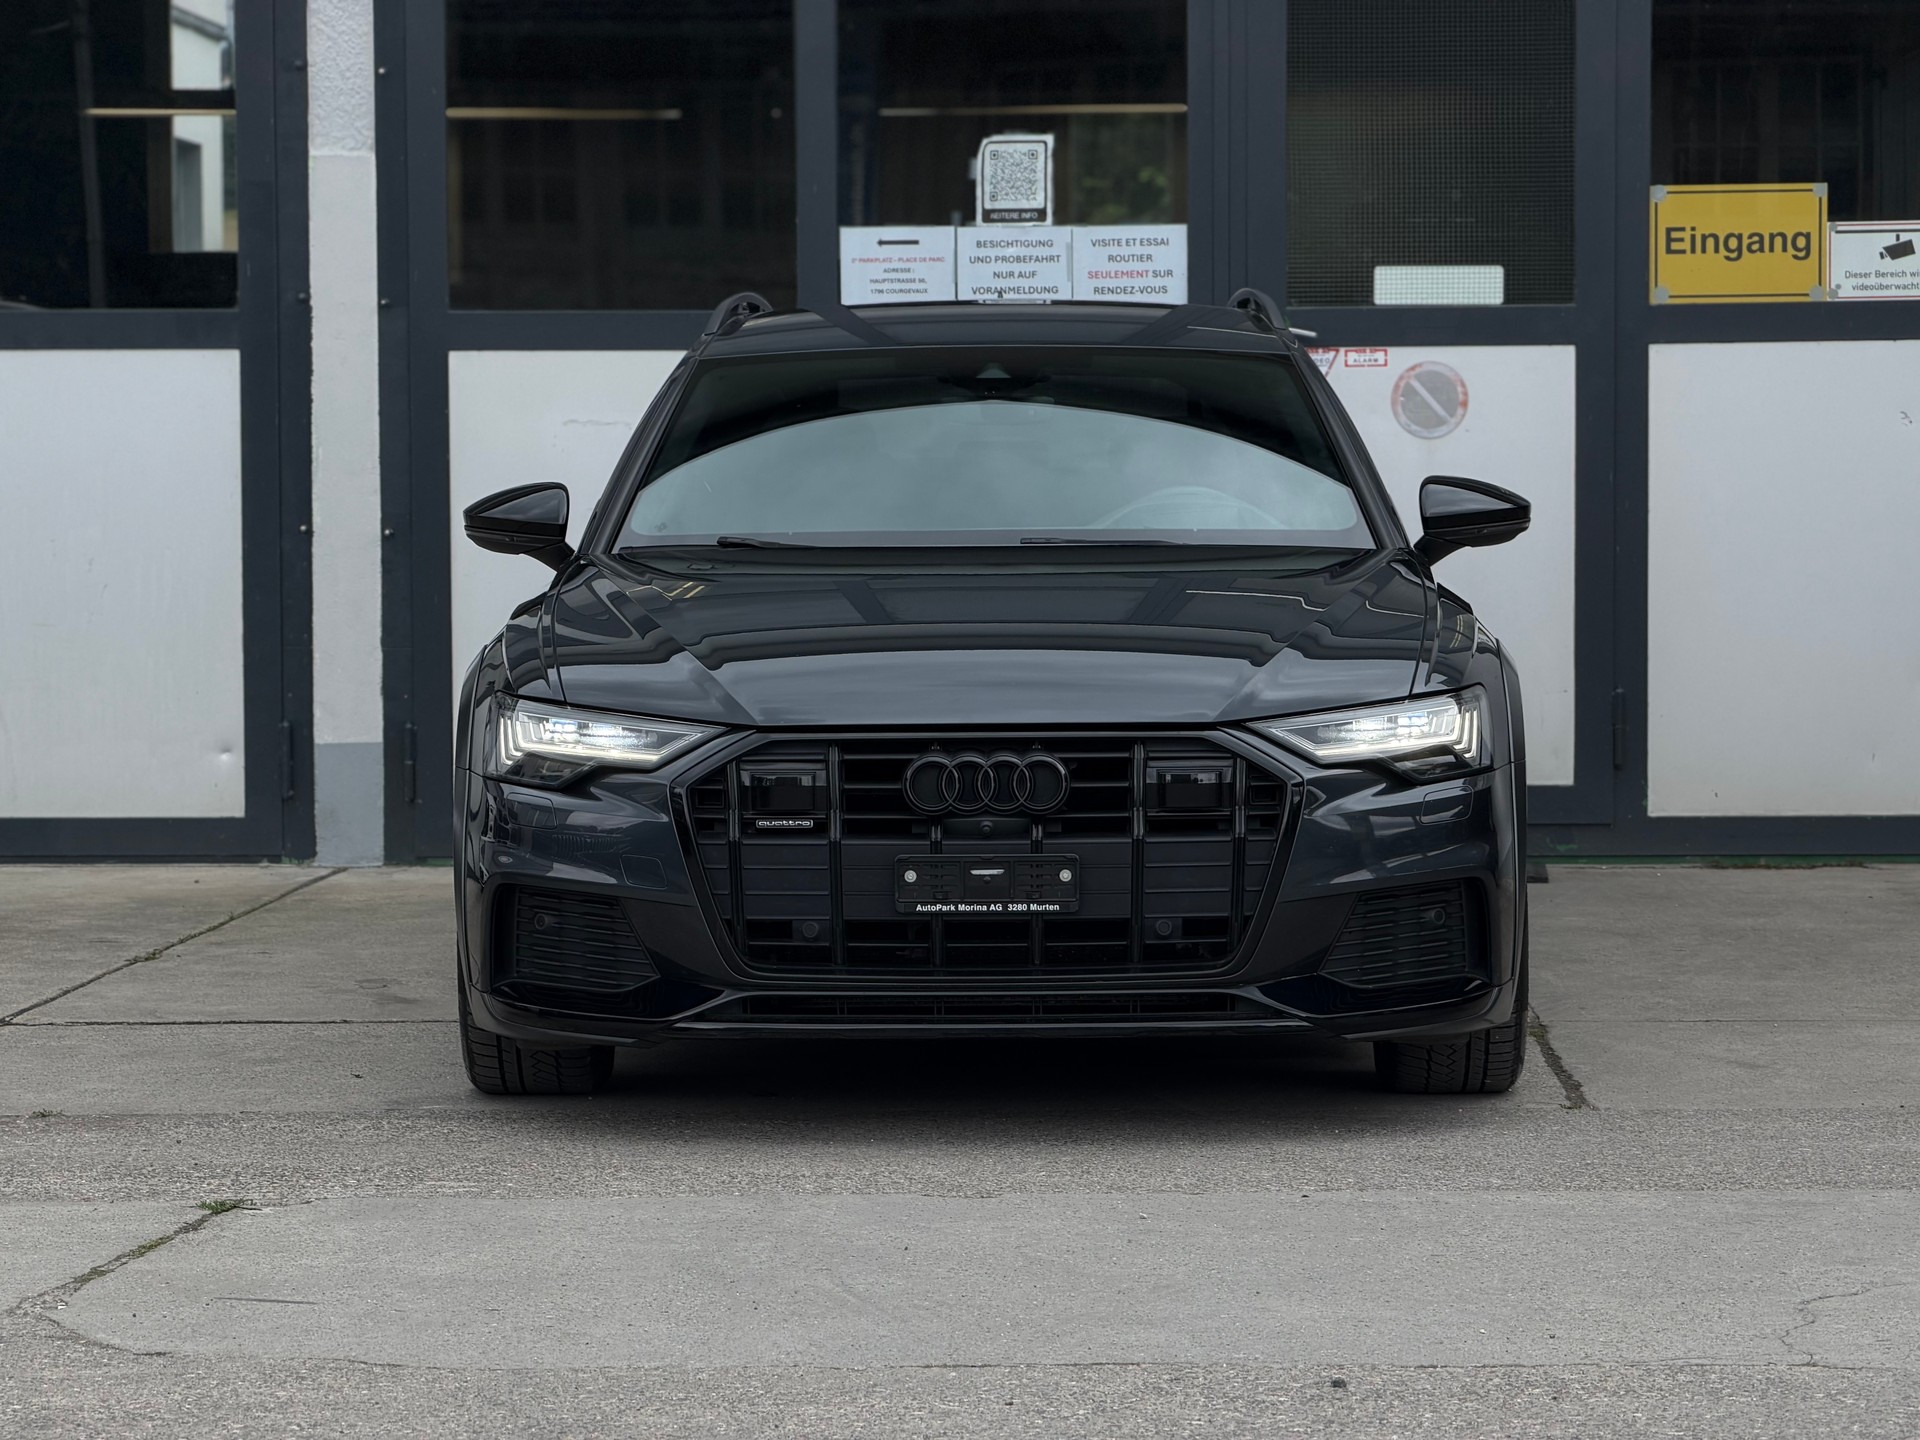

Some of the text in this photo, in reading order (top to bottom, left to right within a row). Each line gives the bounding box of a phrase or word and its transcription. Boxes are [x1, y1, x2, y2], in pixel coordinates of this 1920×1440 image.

[976, 240, 1054, 248] BESICHTIGUNG
[1091, 238, 1169, 247] VISITE ET ESSAI
[1665, 226, 1811, 262] Eingang
[969, 255, 1061, 264] UND PROBEFAHRT
[1108, 254, 1153, 263] ROUTIER
[993, 271, 1037, 279] NUR AUF
[1088, 269, 1173, 279] SEULEMENT SUR
[1845, 269, 1920, 279] Dieser Bereich wi
[971, 286, 1059, 295] VORANMELDUNG
[1094, 286, 1168, 295] RENDEZ-VOUS
[1852, 282, 1919, 291] videoüberwacht
